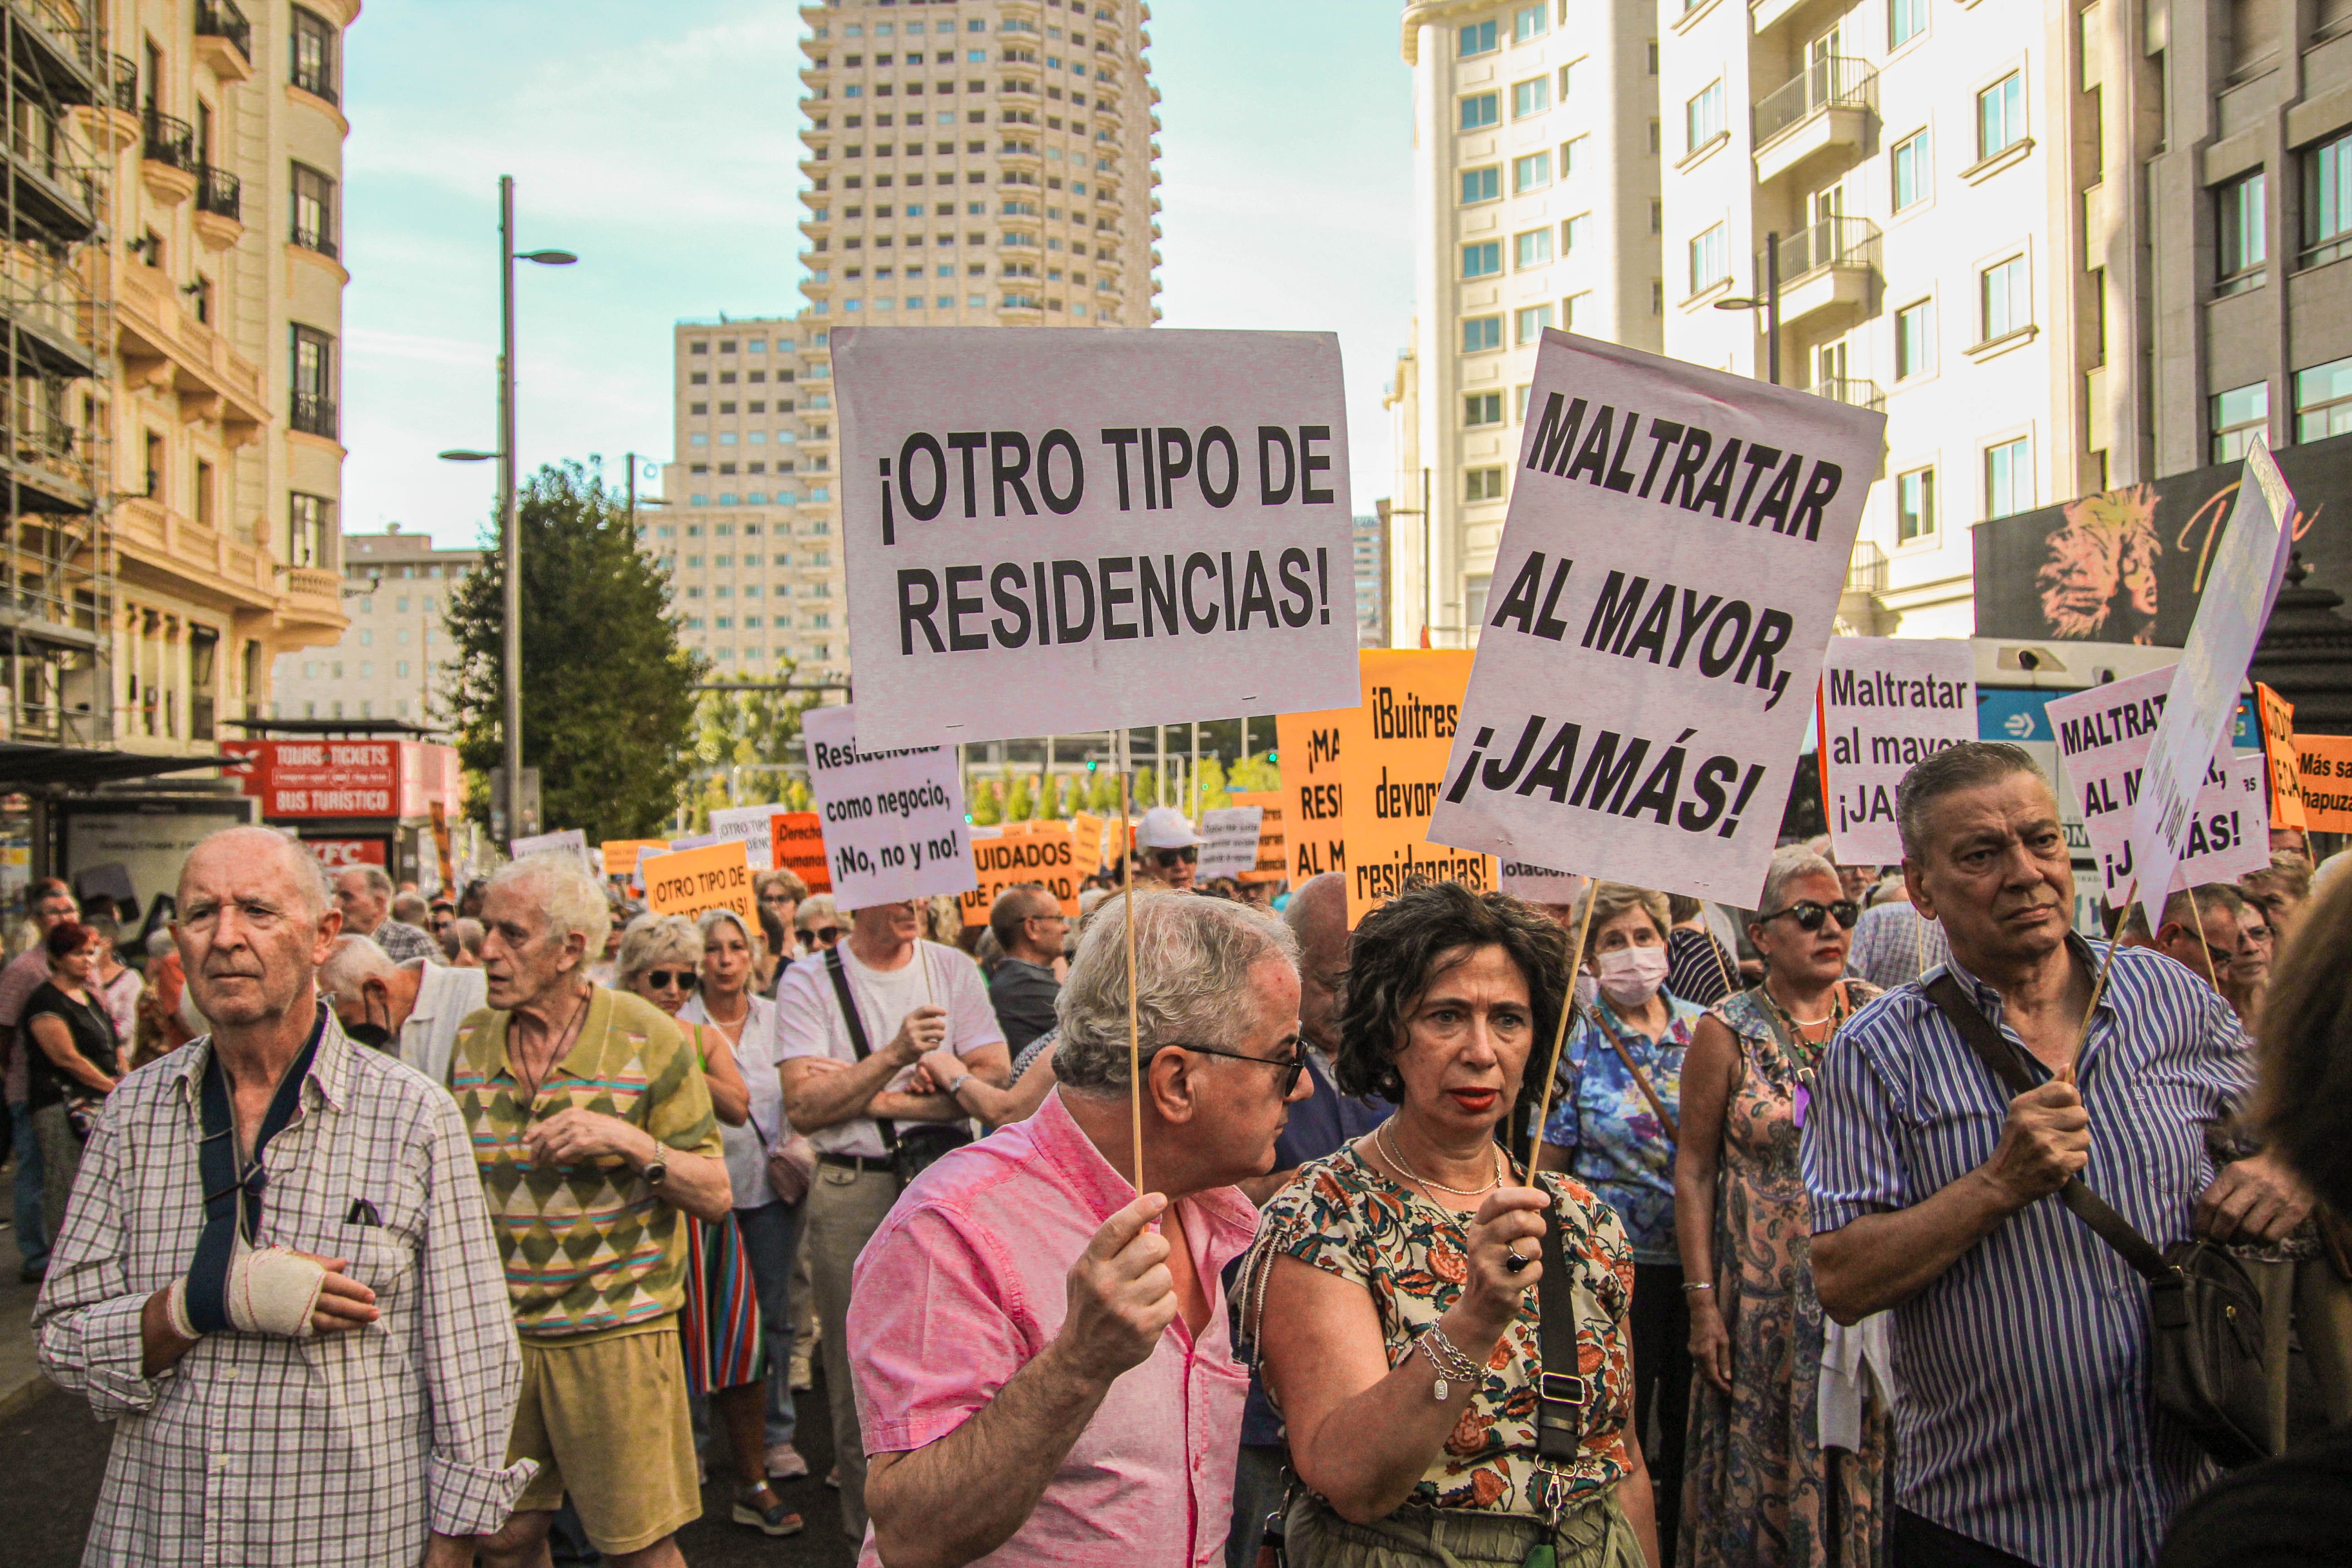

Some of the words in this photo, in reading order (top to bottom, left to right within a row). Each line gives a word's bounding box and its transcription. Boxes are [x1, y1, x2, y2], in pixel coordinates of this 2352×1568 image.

[879, 429, 1084, 545] ¡OTRO
[1101, 426, 1239, 510] TIPO
[1258, 426, 1334, 505] DE
[1526, 392, 1842, 542] MALTRATAR
[897, 547, 1330, 655] RESIDENCIAS!
[1490, 551, 1573, 641] AL
[1580, 570, 1793, 711] MAYOR,
[1831, 668, 1967, 709] Maltratar
[1373, 687, 1457, 739] ¡Buitres
[275, 745, 323, 766] TOURS
[330, 745, 389, 766] TICKETS
[1834, 726, 1860, 764] al
[1376, 766, 1443, 818] devor
[1446, 715, 1765, 838] ¡JAMÁS!
[2086, 779, 2118, 818] AL
[276, 790, 308, 811] BUS
[826, 796, 872, 822] como
[877, 779, 950, 818] negocio,
[1840, 785, 1901, 833] ¡JA
[836, 845, 876, 882] ¡No,
[881, 845, 905, 867] no
[910, 842, 921, 870] y
[928, 830, 959, 860] no!
[975, 842, 1071, 871] UIDADOS
[1298, 842, 1324, 877] AL
[653, 876, 694, 909] ¡OTRO
[697, 870, 726, 893] TIPO
[729, 865, 746, 887] DE
[965, 883, 988, 908] DE
